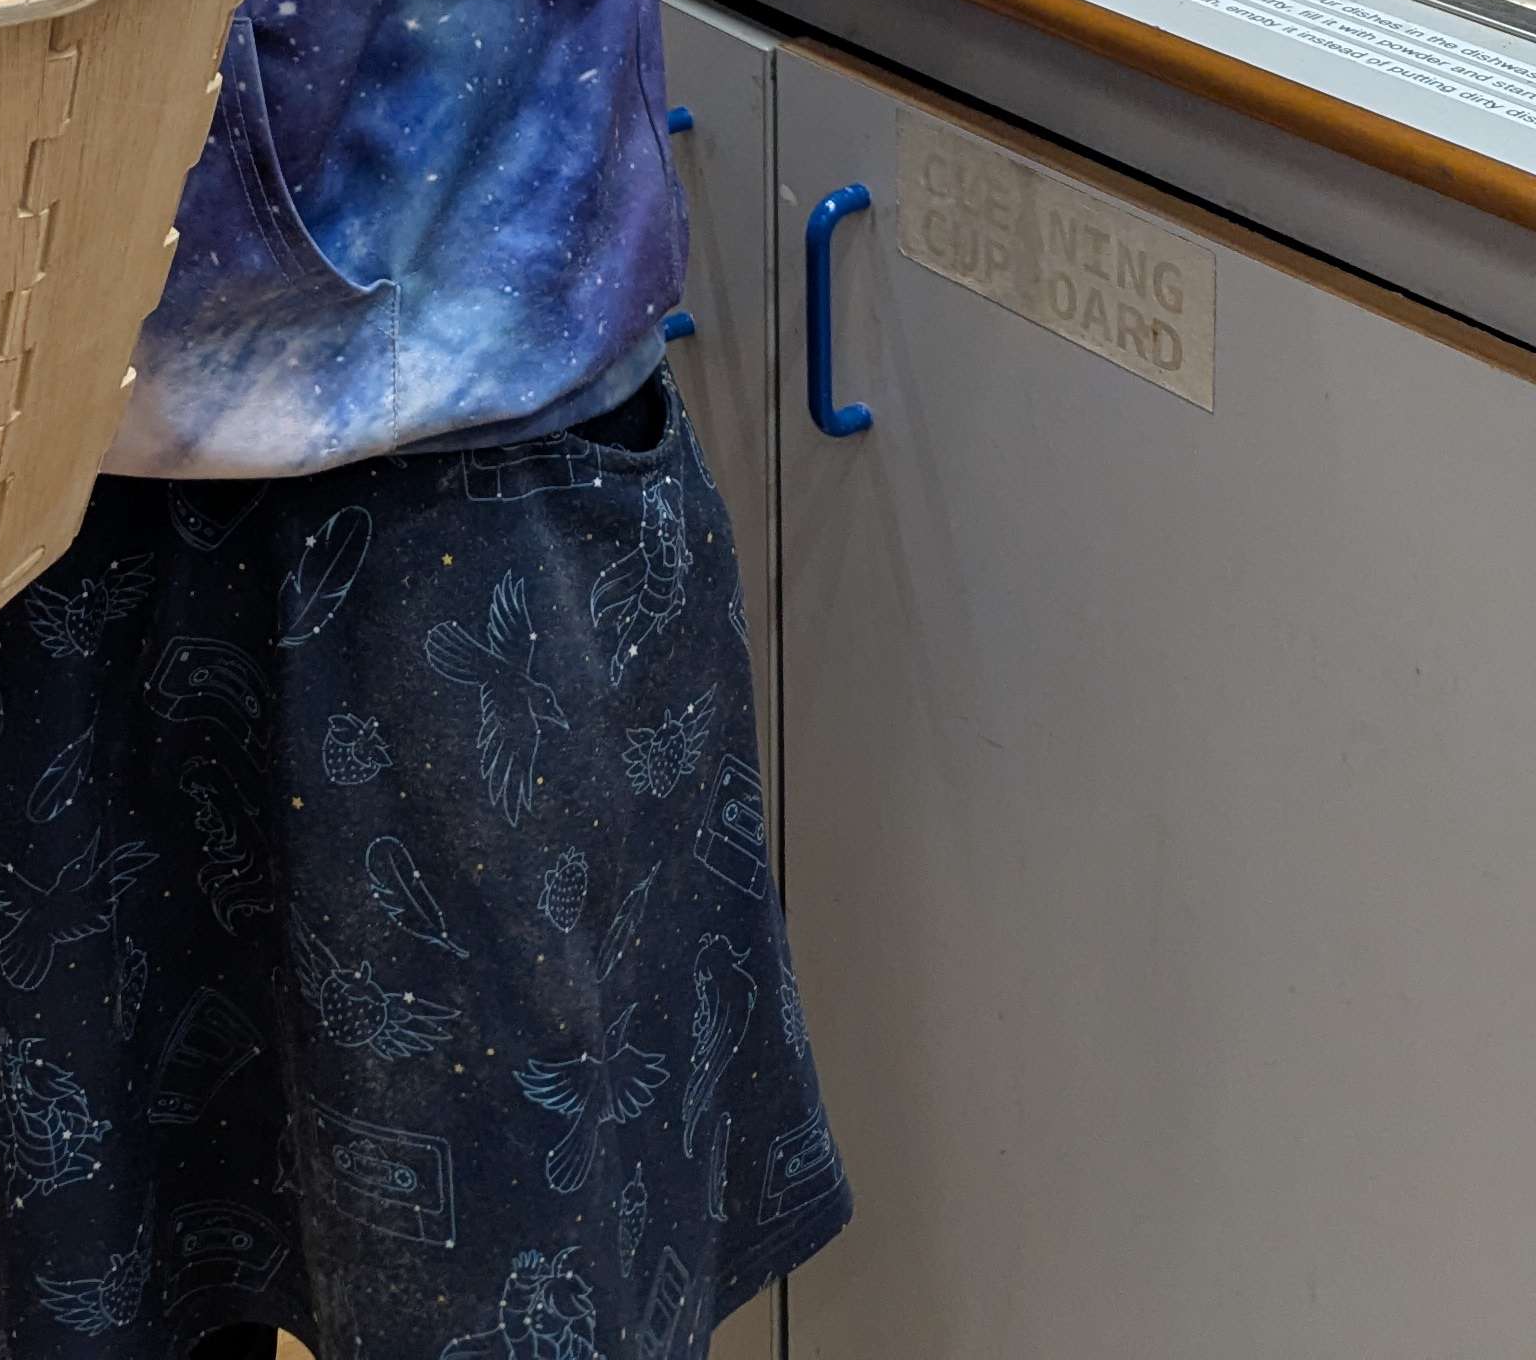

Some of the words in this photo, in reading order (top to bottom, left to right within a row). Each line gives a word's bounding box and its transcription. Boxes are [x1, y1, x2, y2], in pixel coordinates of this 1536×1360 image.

[1225, 6, 1282, 29] empty
[1282, 24, 1299, 34] it
[1297, 30, 1368, 60] instead
[1366, 55, 1392, 68] of
[1386, 63, 1457, 94] putting
[1459, 92, 1505, 109] dirty
[1506, 109, 1536, 124] dis
[1299, 9, 1323, 21] fill
[1322, 16, 1338, 28] it
[1339, 22, 1377, 42] with
[1377, 35, 1451, 68] powder
[1450, 66, 1494, 82] and
[1342, 3, 1404, 30] dishes
[1405, 26, 1425, 38] in
[1426, 34, 1458, 51] the
[923, 207, 1184, 373] CUPOARD
[925, 151, 1184, 315] CLENING
